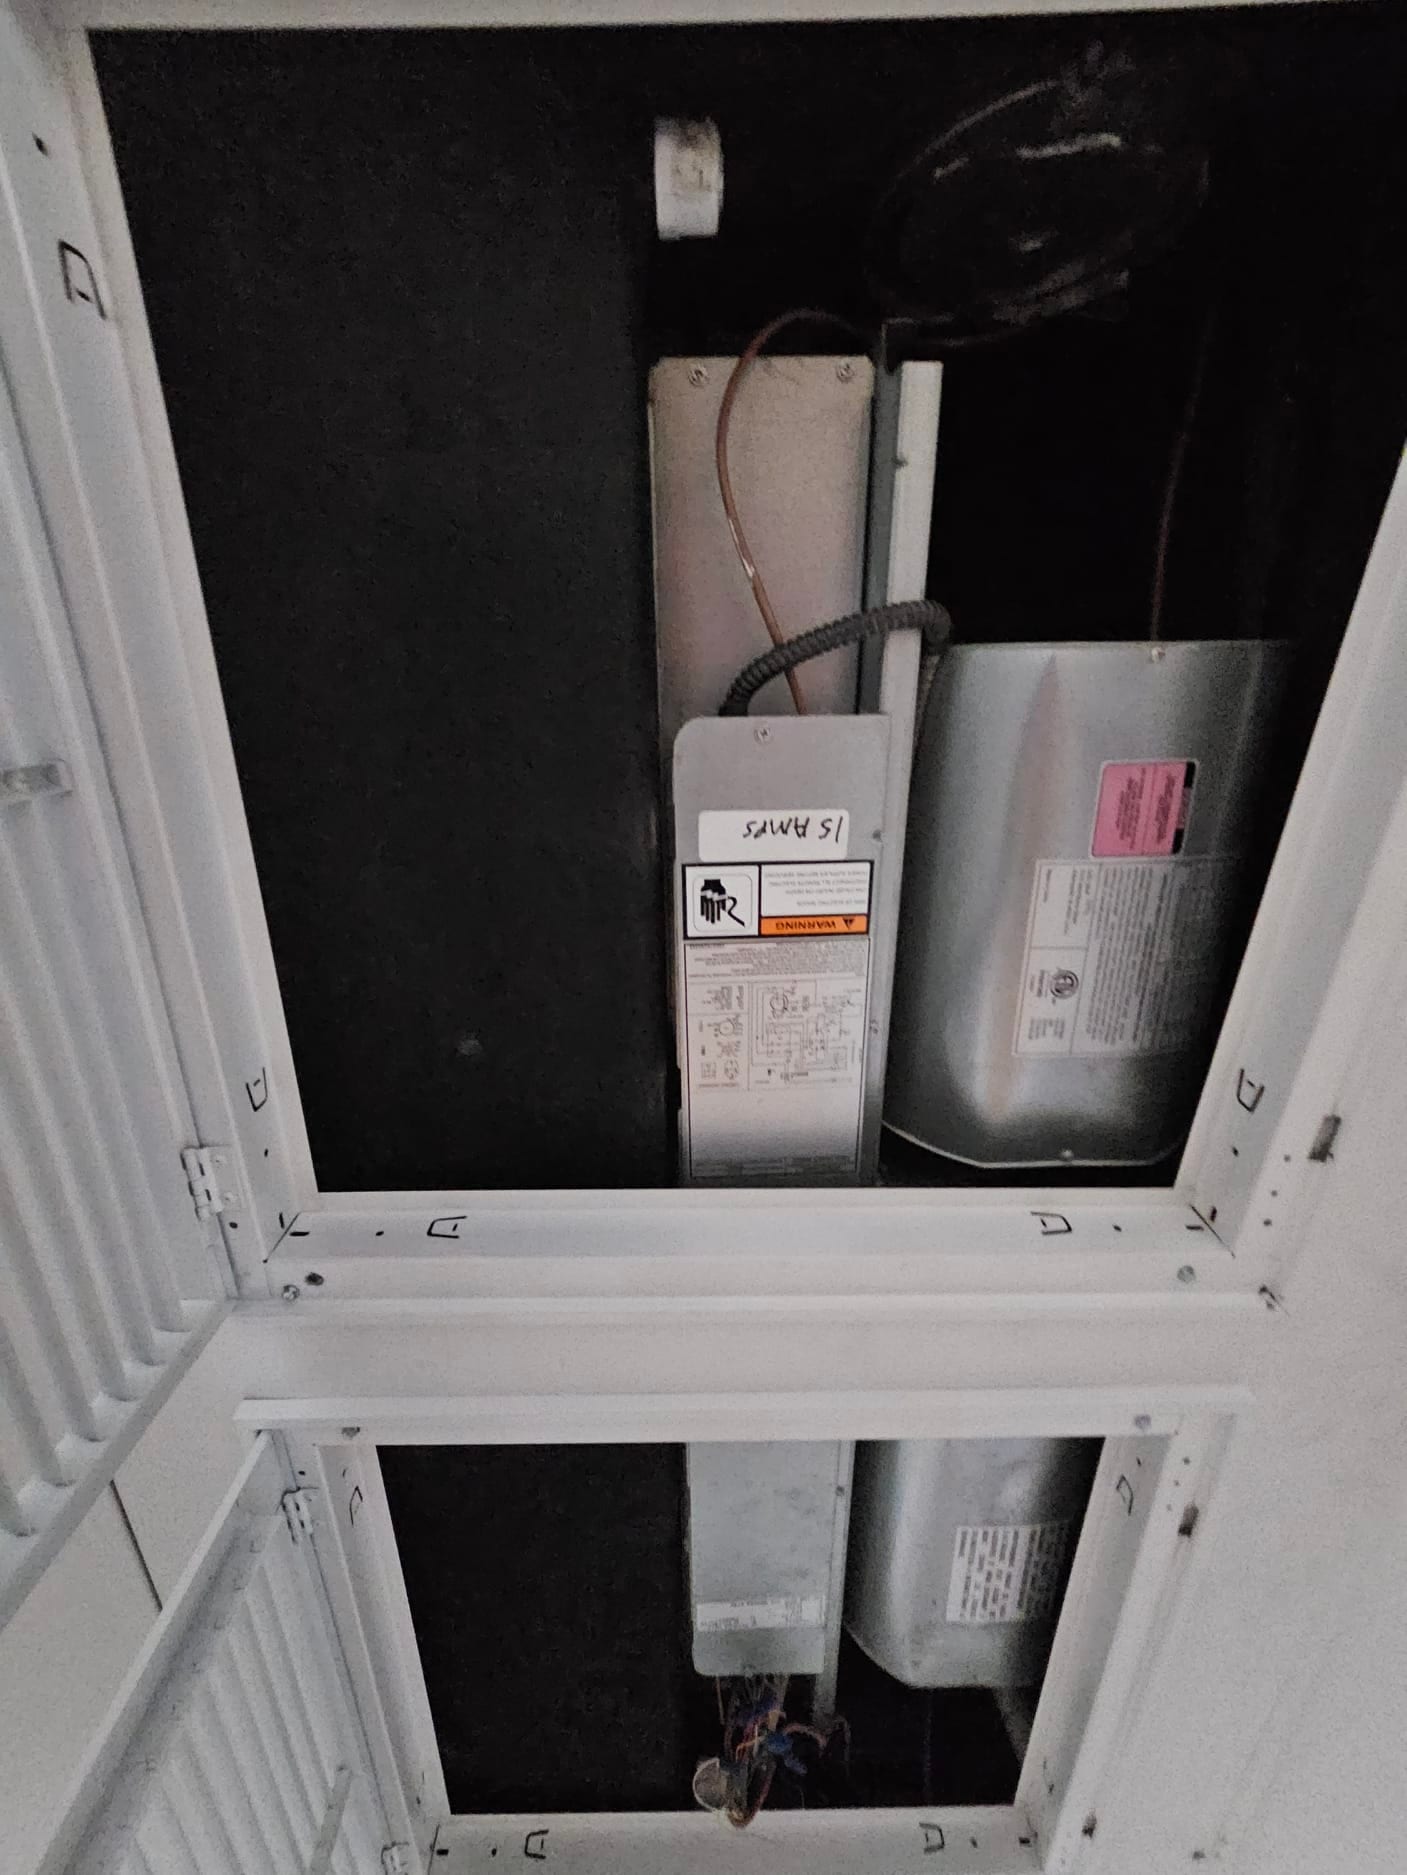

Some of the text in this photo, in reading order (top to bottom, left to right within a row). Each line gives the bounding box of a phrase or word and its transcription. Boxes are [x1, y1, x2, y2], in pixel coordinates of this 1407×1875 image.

[742, 816, 843, 843] 15 AMPS
[775, 919, 836, 931] WARNING
